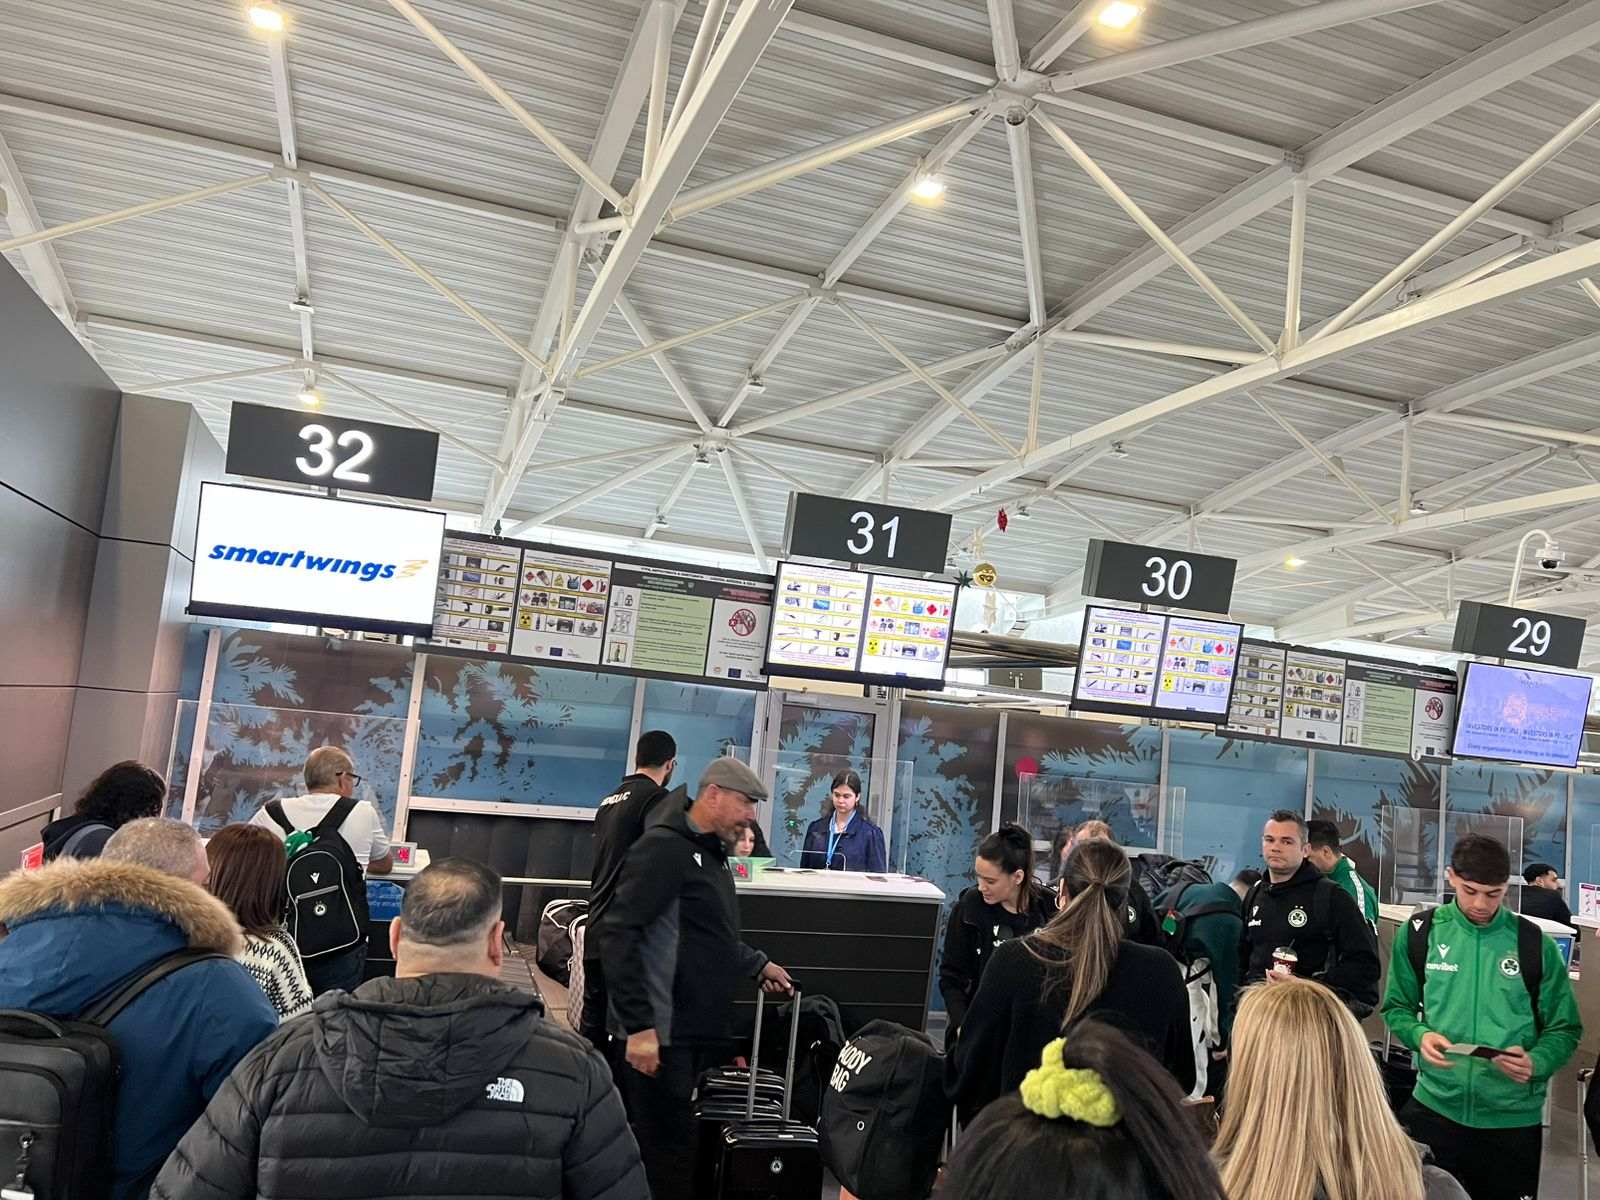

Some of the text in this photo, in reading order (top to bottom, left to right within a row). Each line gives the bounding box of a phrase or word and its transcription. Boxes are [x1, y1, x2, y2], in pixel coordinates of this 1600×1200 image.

[295, 424, 373, 483] 32
[847, 511, 901, 558] 31
[207, 544, 396, 583] smartwings
[1141, 556, 1192, 600] 30
[1507, 617, 1551, 656] 29
[830, 1063, 848, 1092] BAG
